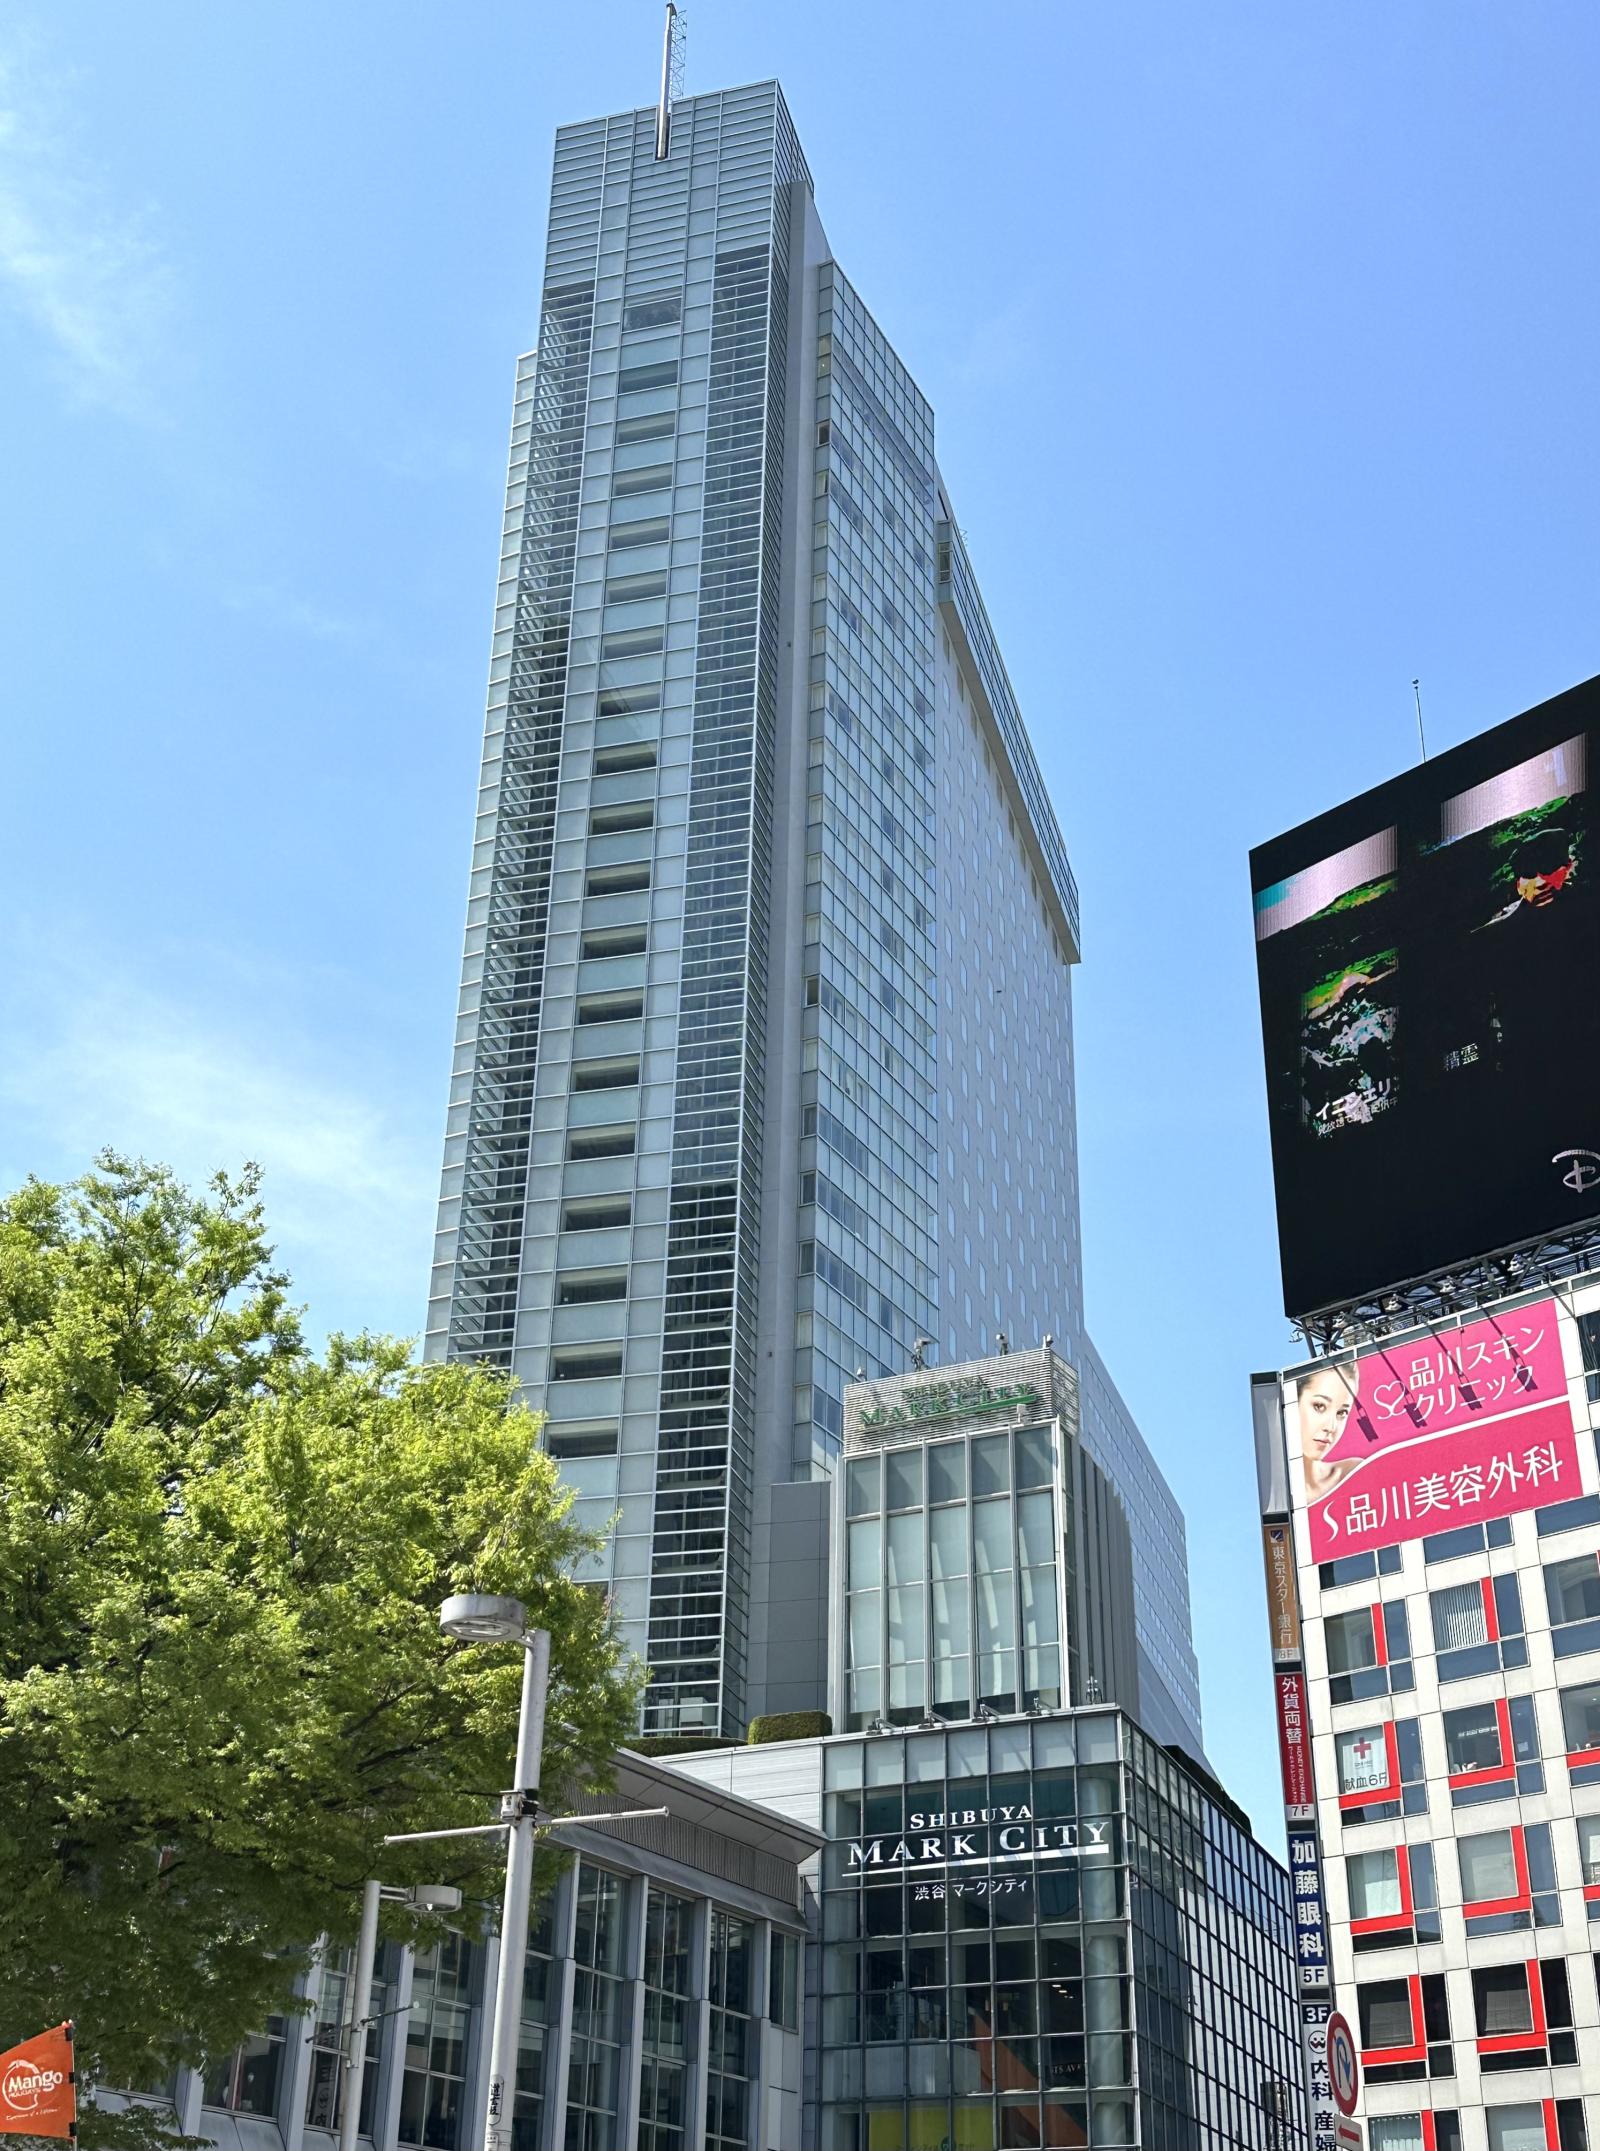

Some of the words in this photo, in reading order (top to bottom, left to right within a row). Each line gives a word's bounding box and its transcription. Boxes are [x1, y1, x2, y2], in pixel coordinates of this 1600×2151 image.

[1409, 1327, 1545, 1391] 品川スキン
[859, 1398, 949, 1426] MARK
[956, 1382, 1033, 1406] CITY
[1413, 1364, 1534, 1423] クリニック
[1345, 1441, 1563, 1536] 品川美容外科
[1272, 1546, 1293, 1645] 東京スター銀行
[1279, 1649, 1294, 1660] 8F
[1282, 1676, 1302, 1745] 外貨両替
[910, 1805, 1033, 1830] SHIBUYA
[1291, 1806, 1309, 1817] 7F
[847, 1833, 977, 1866] MARK
[999, 1821, 1110, 1851] CITY
[1292, 1839, 1324, 1958] 加藤眼科
[1303, 1968, 1325, 1983] 5F
[1305, 2007, 1328, 2022] 3F
[8, 2070, 63, 2092] Mango
